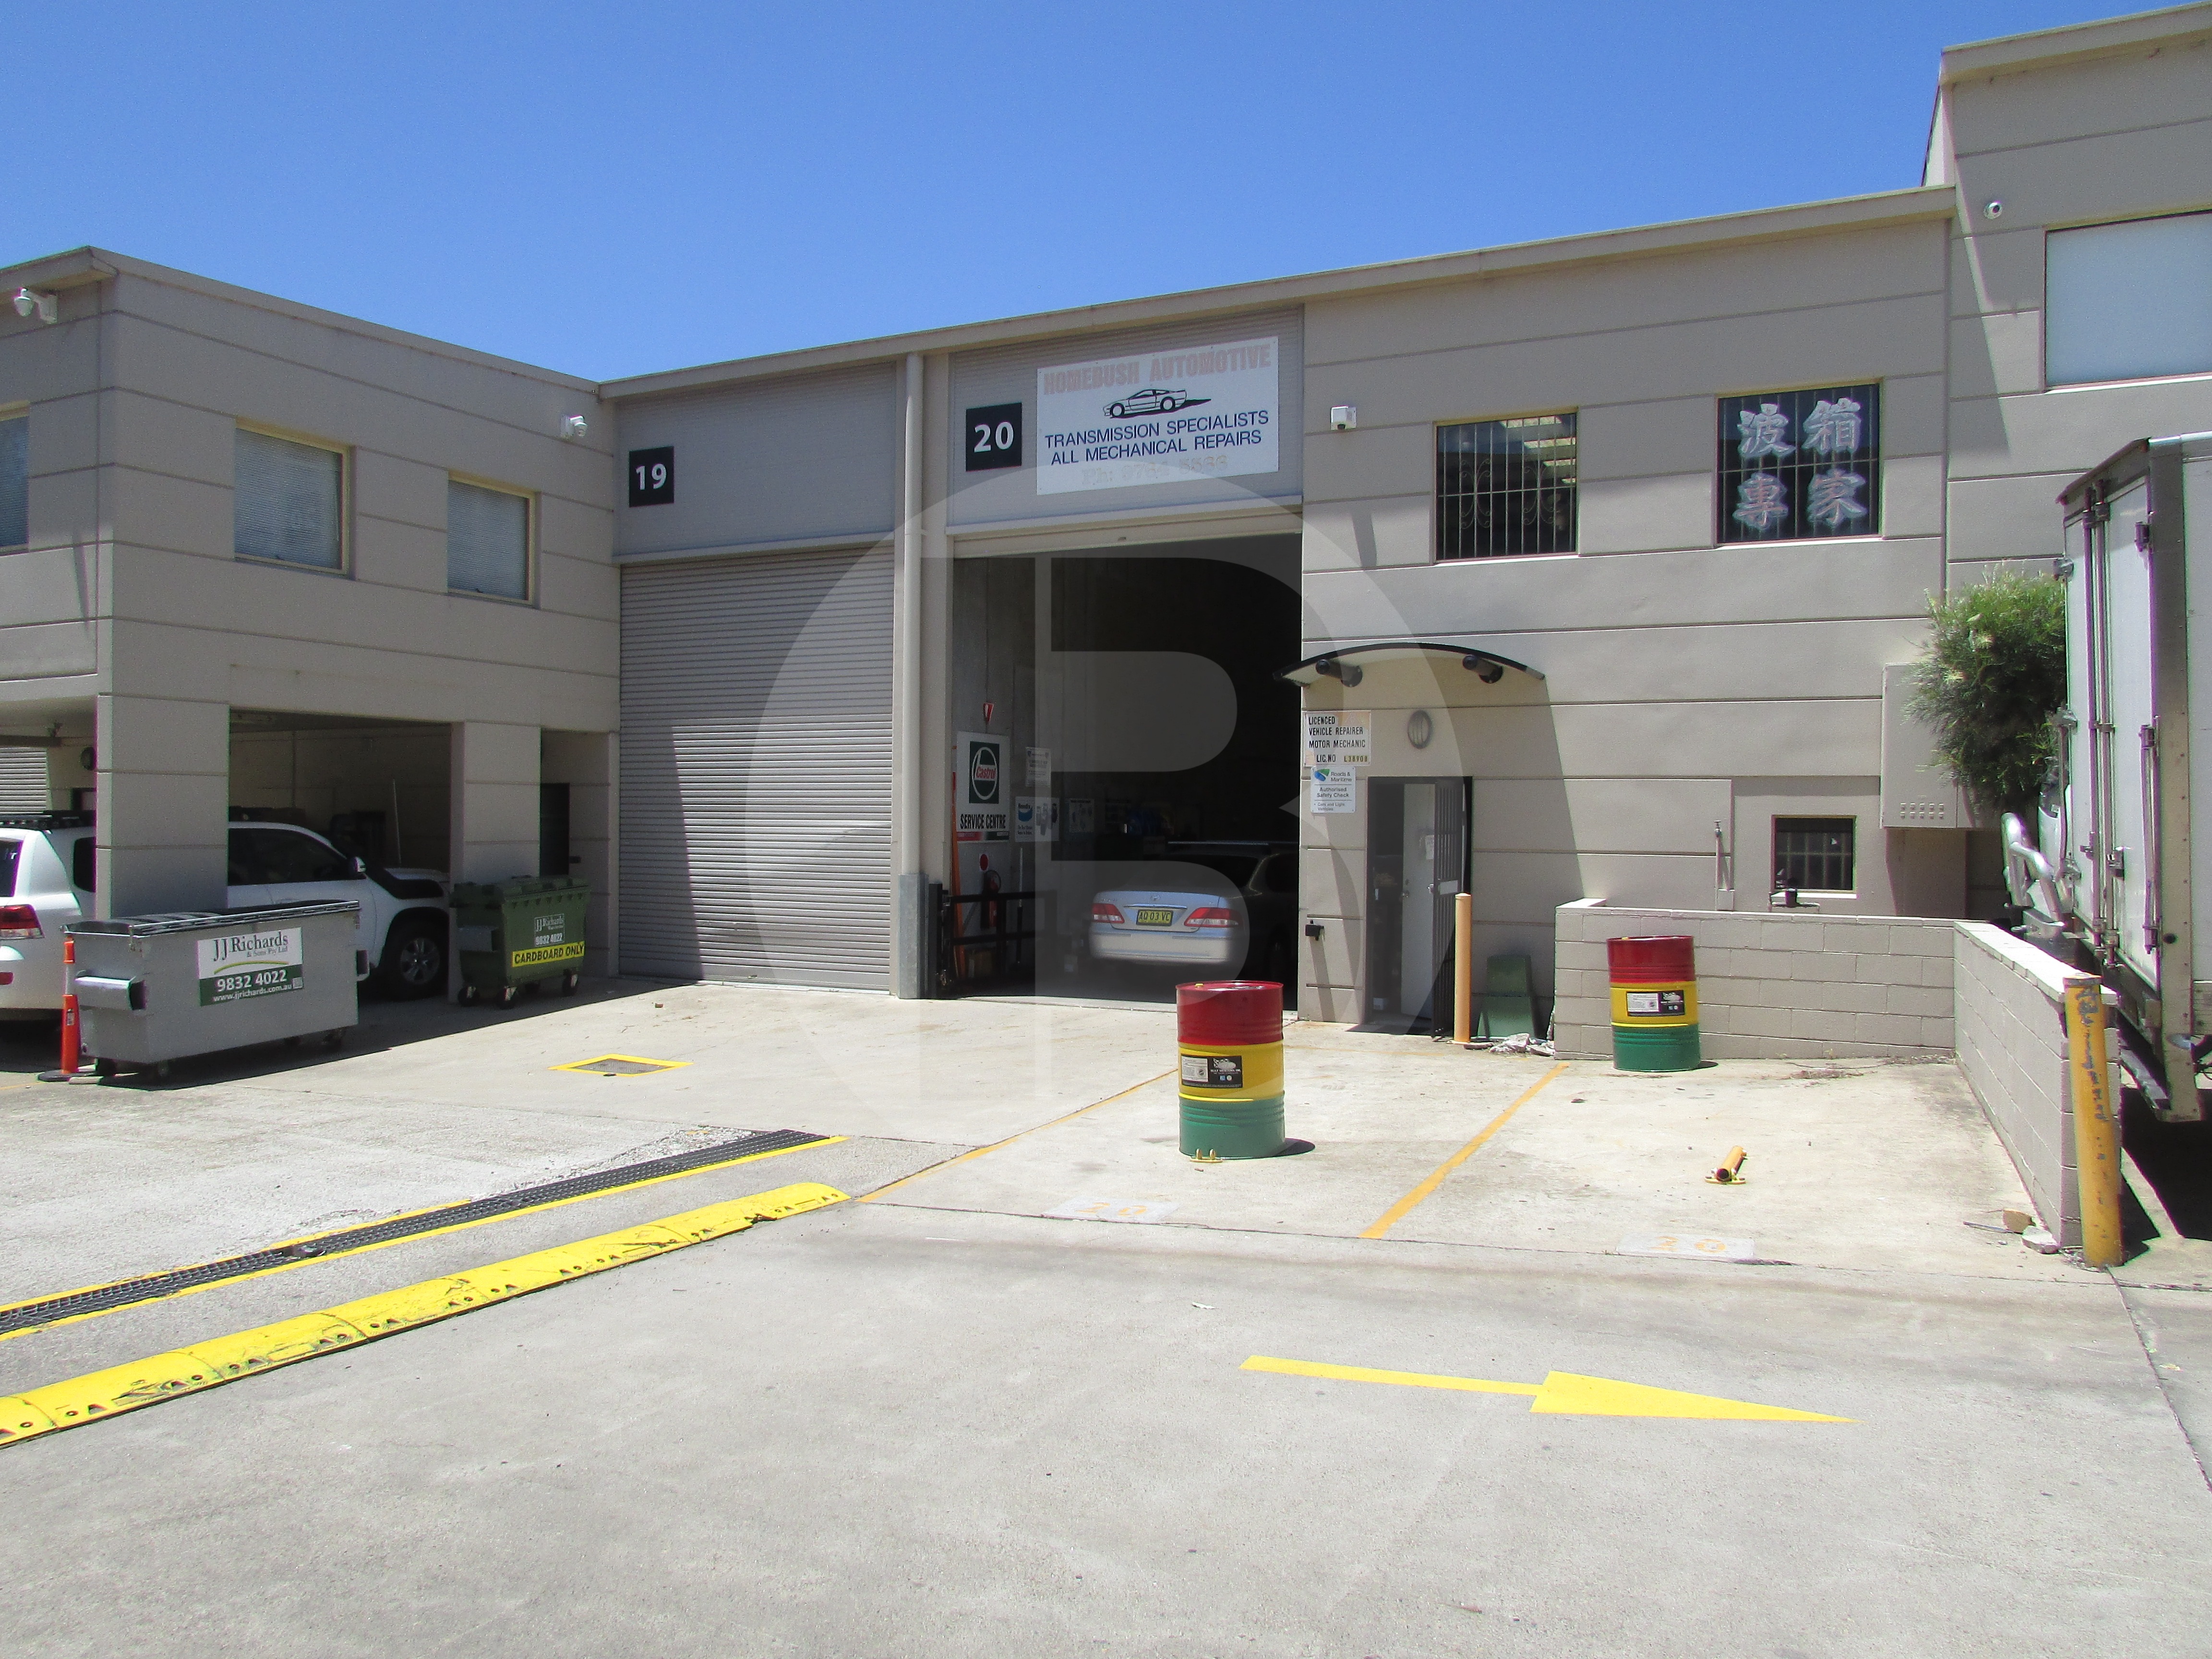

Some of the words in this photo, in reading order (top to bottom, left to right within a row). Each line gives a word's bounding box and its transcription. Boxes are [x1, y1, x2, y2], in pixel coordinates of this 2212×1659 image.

[1044, 361, 1140, 396] HOMEBUSH
[1149, 344, 1271, 382] AUTOMOTIVE
[973, 421, 1014, 453] 20
[1045, 422, 1160, 449] TRANSMISSION
[1166, 410, 1269, 435] SPECIALISTS
[1051, 450, 1079, 466] ALL
[1085, 438, 1187, 462] MECHANICAL
[1194, 430, 1262, 450] REPAIRS
[635, 463, 667, 490] 19
[1309, 716, 1335, 725] LICENCED
[1309, 727, 1332, 735] VEHICLE
[1335, 727, 1363, 735] REPAIRER
[1309, 740, 1330, 748] MOTOR
[1333, 739, 1366, 748] MECHANIC
[976, 766, 996, 779] Castrol
[960, 814, 985, 830] SERVICE
[986, 814, 1006, 829] CENTRE
[1150, 912, 1159, 920] 03
[1162, 912, 1170, 921] VC
[515, 947, 564, 964] CARDBOARD
[565, 944, 584, 956] ONLY
[217, 974, 252, 992] 9832
[255, 969, 288, 986] 4022
[213, 984, 292, 1002] www.jjrichards.com.au
[1650, 1236, 1726, 1253] 20
